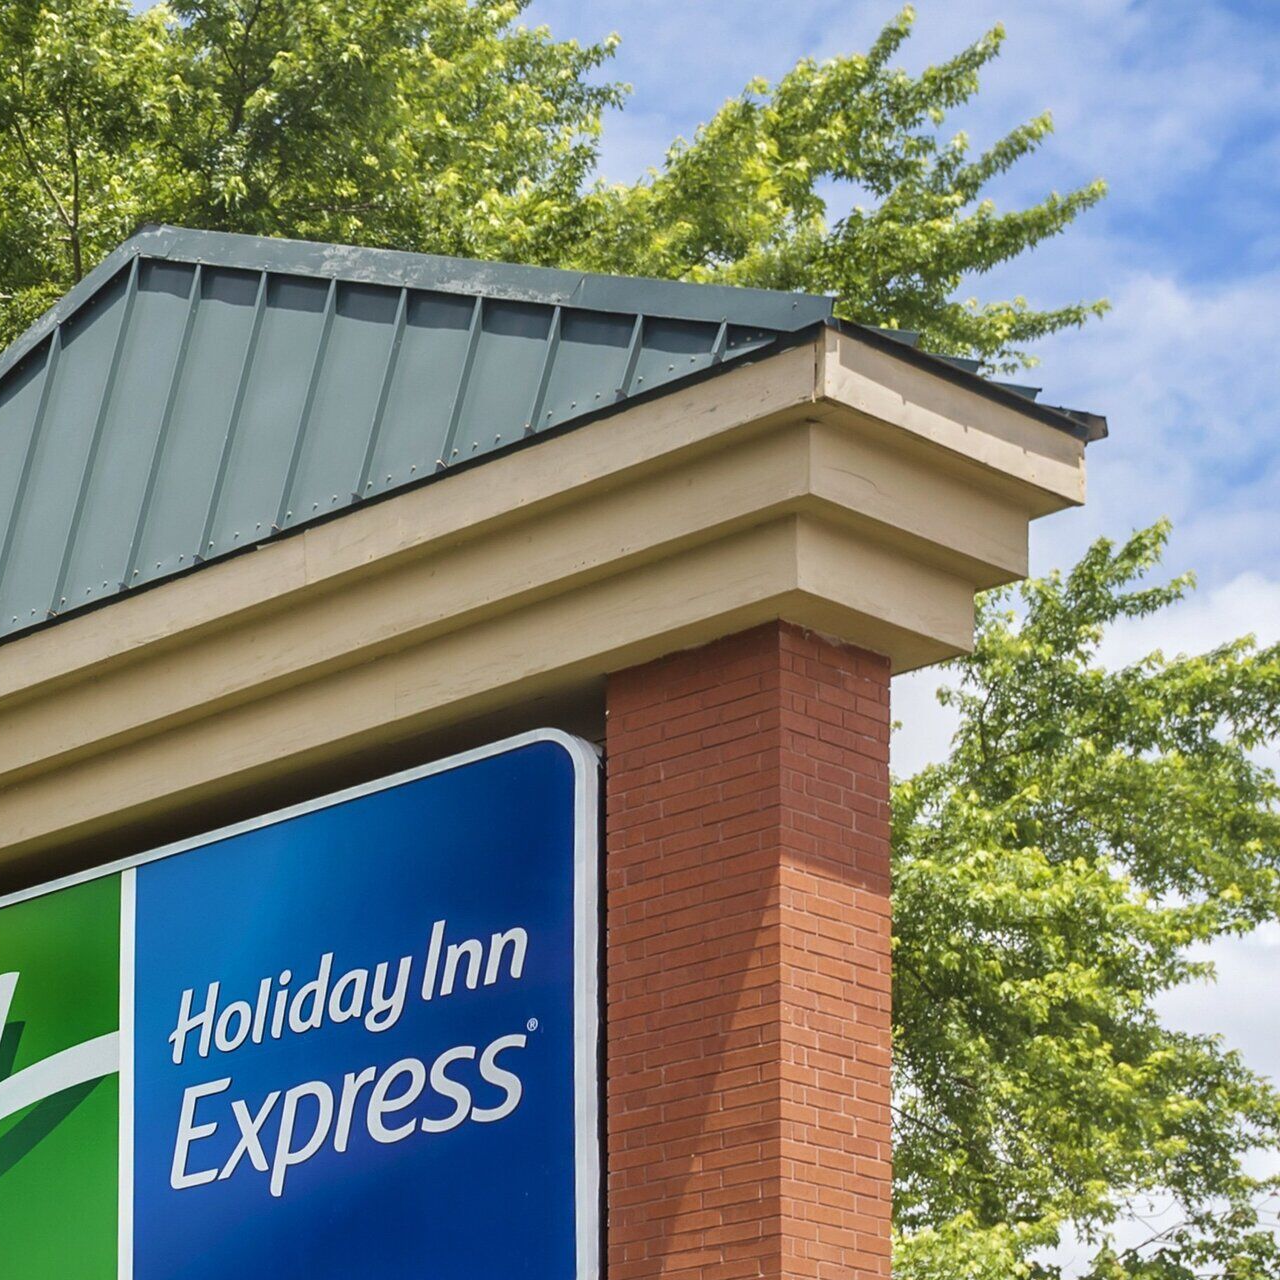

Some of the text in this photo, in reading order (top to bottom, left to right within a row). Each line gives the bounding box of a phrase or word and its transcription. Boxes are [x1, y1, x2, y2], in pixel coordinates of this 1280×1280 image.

[168, 919, 529, 1065] Holiday Inn
[169, 1033, 528, 1198] Express
